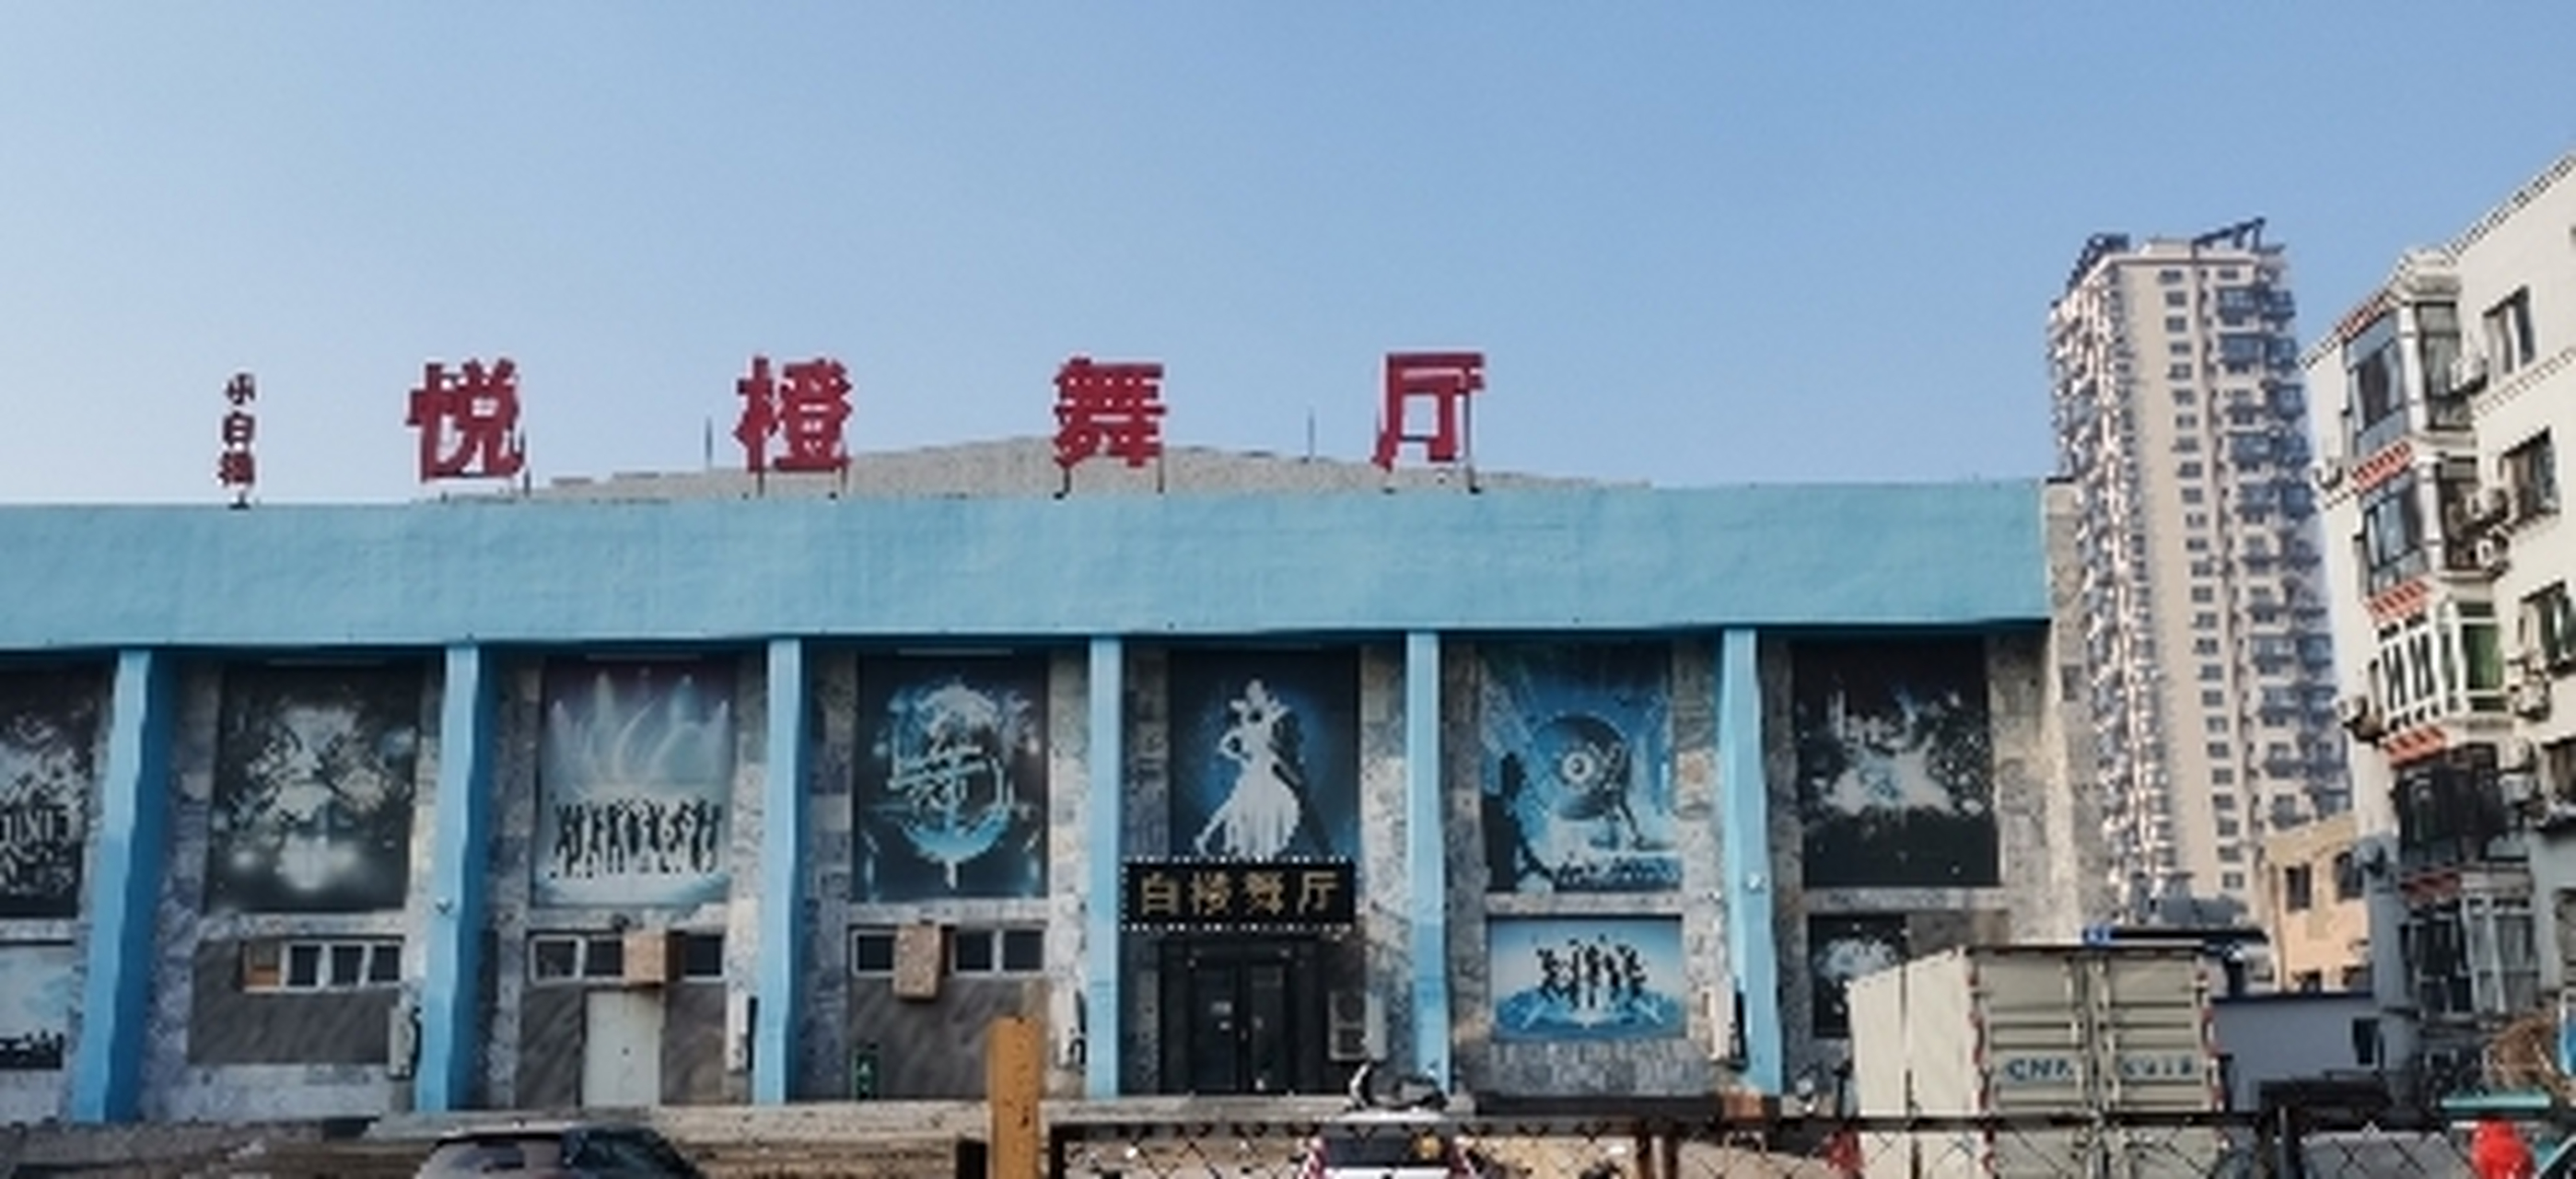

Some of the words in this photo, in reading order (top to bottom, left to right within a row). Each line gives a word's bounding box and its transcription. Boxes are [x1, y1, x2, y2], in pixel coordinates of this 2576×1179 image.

[406, 352, 1486, 483] 悦橙舞厅
[1138, 870, 1339, 916] 白楼舞厅
